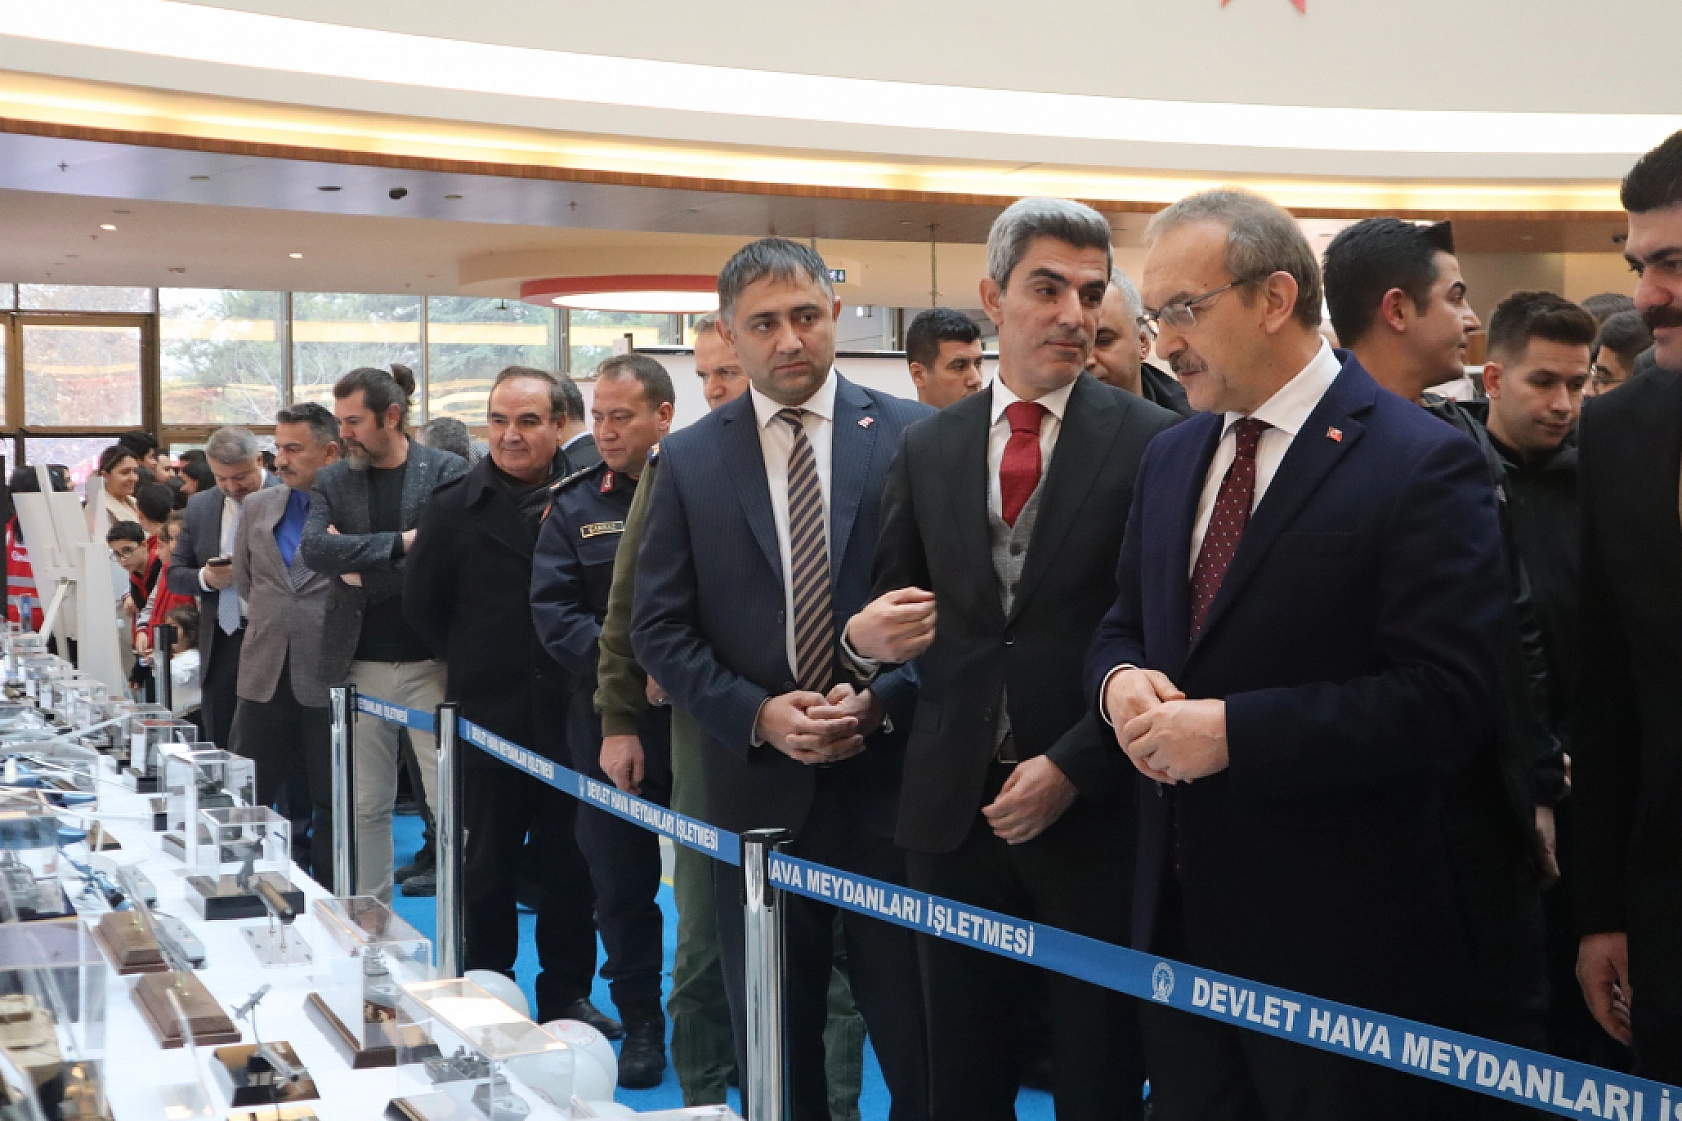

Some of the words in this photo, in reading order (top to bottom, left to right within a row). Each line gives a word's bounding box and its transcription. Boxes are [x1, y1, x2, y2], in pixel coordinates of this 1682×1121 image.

[587, 780, 610, 806] DEVLET
[611, 790, 628, 814] HAVA
[629, 798, 675, 835] MEYDANLARI
[676, 814, 718, 852] İŞLETMESİ
[807, 869, 921, 924] MEYDANLARI
[926, 897, 1034, 957] İŞLETMESİ
[1191, 976, 1301, 1032] DEVLET
[1308, 1008, 1392, 1060] HAVA
[1401, 1032, 1643, 1121] MEYDANLARI
